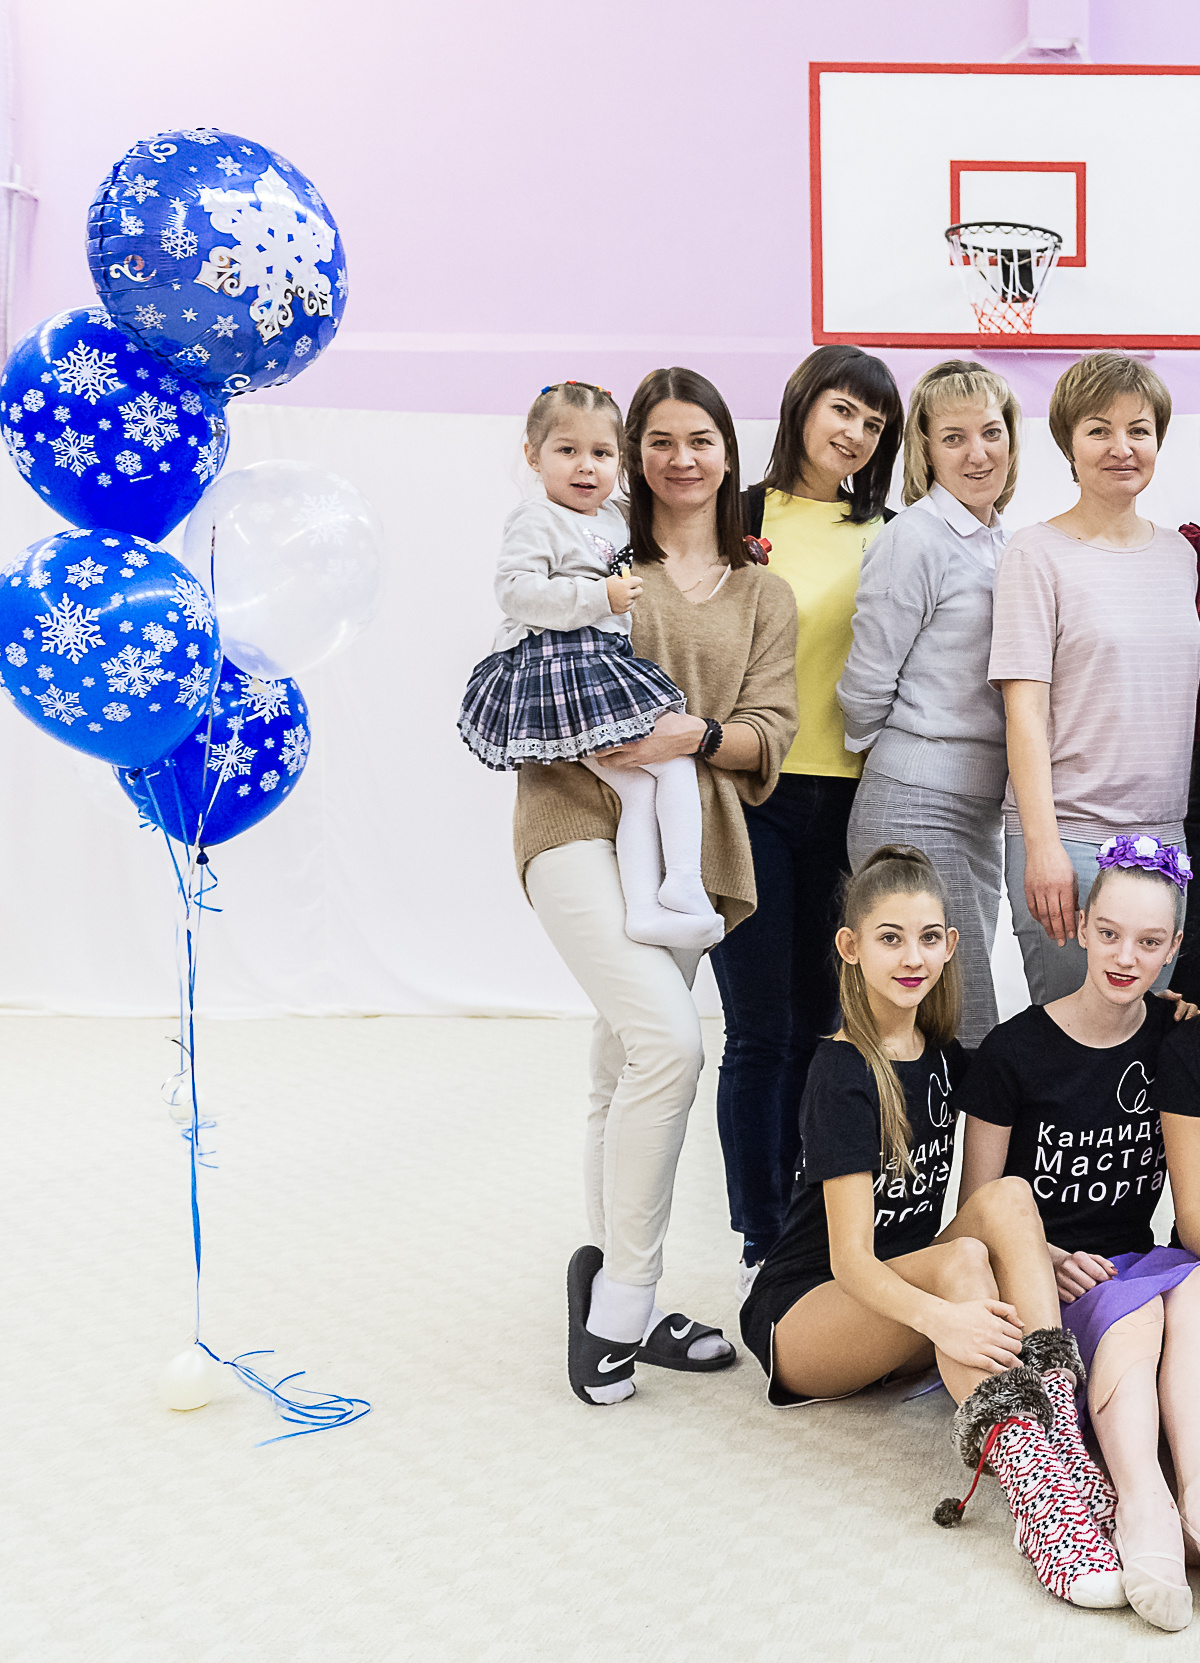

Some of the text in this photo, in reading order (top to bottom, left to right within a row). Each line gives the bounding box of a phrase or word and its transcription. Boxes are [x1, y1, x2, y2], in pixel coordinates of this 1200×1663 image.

[1037, 1118, 1163, 1149] Кандида
[1034, 1142, 1166, 1177] Мастер
[1033, 1170, 1164, 1206] Спорта
